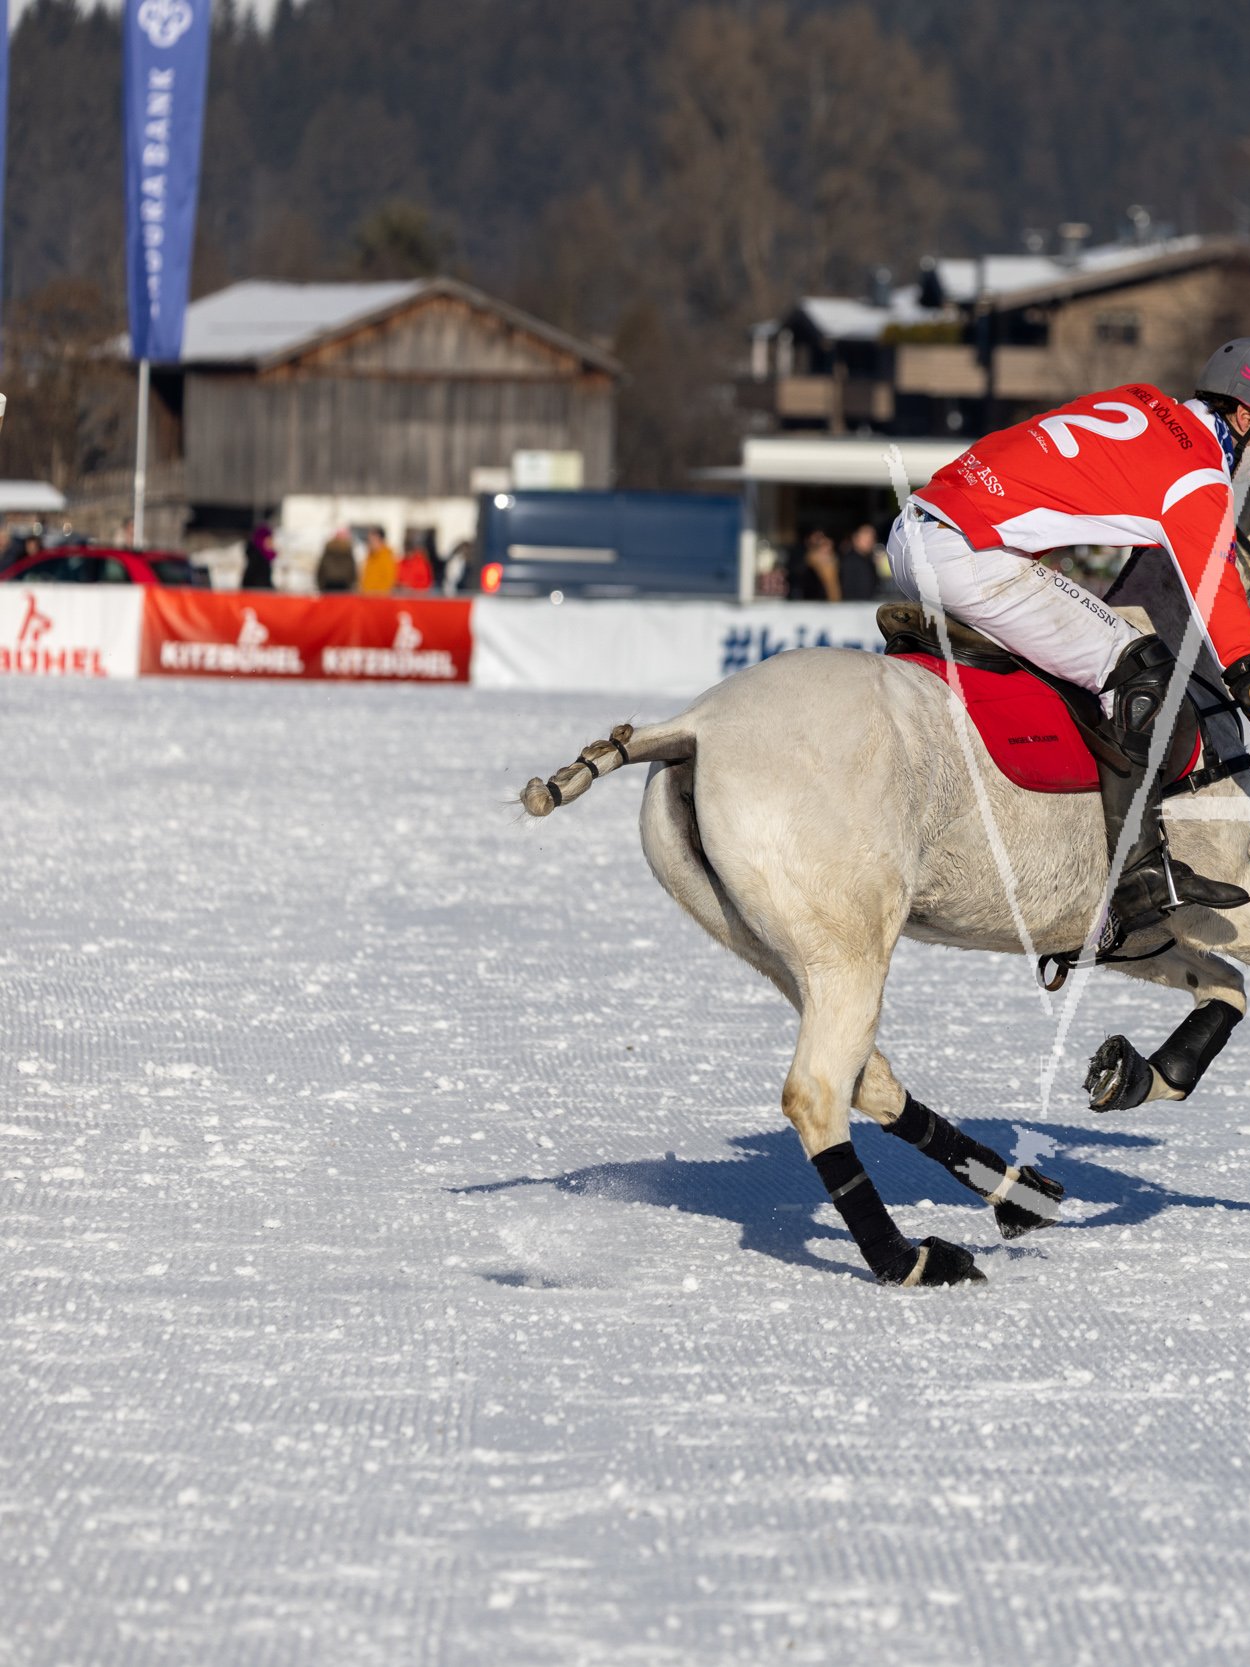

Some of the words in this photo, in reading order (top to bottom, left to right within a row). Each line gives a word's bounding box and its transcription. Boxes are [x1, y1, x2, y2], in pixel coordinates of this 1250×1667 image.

[143, 67, 176, 167] BANK
[1038, 401, 1149, 459] 2
[1080, 597, 1116, 629] ASSN.
